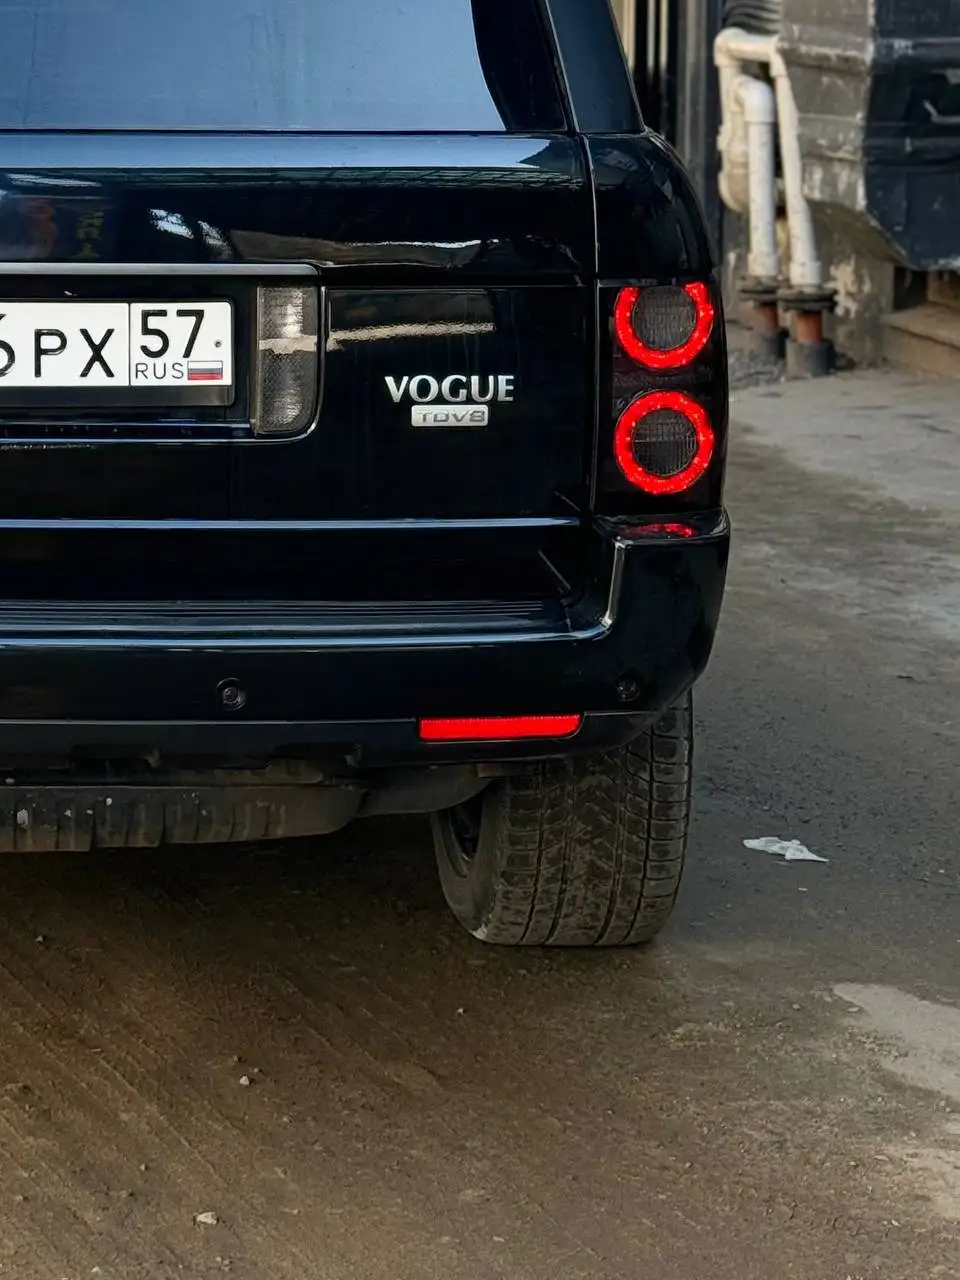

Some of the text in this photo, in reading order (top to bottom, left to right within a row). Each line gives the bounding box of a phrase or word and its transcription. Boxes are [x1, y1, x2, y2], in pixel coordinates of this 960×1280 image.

[140, 309, 205, 359] 57
[135, 362, 184, 379] RUS
[384, 374, 515, 403] VOGUE
[416, 410, 486, 423] TDV8
